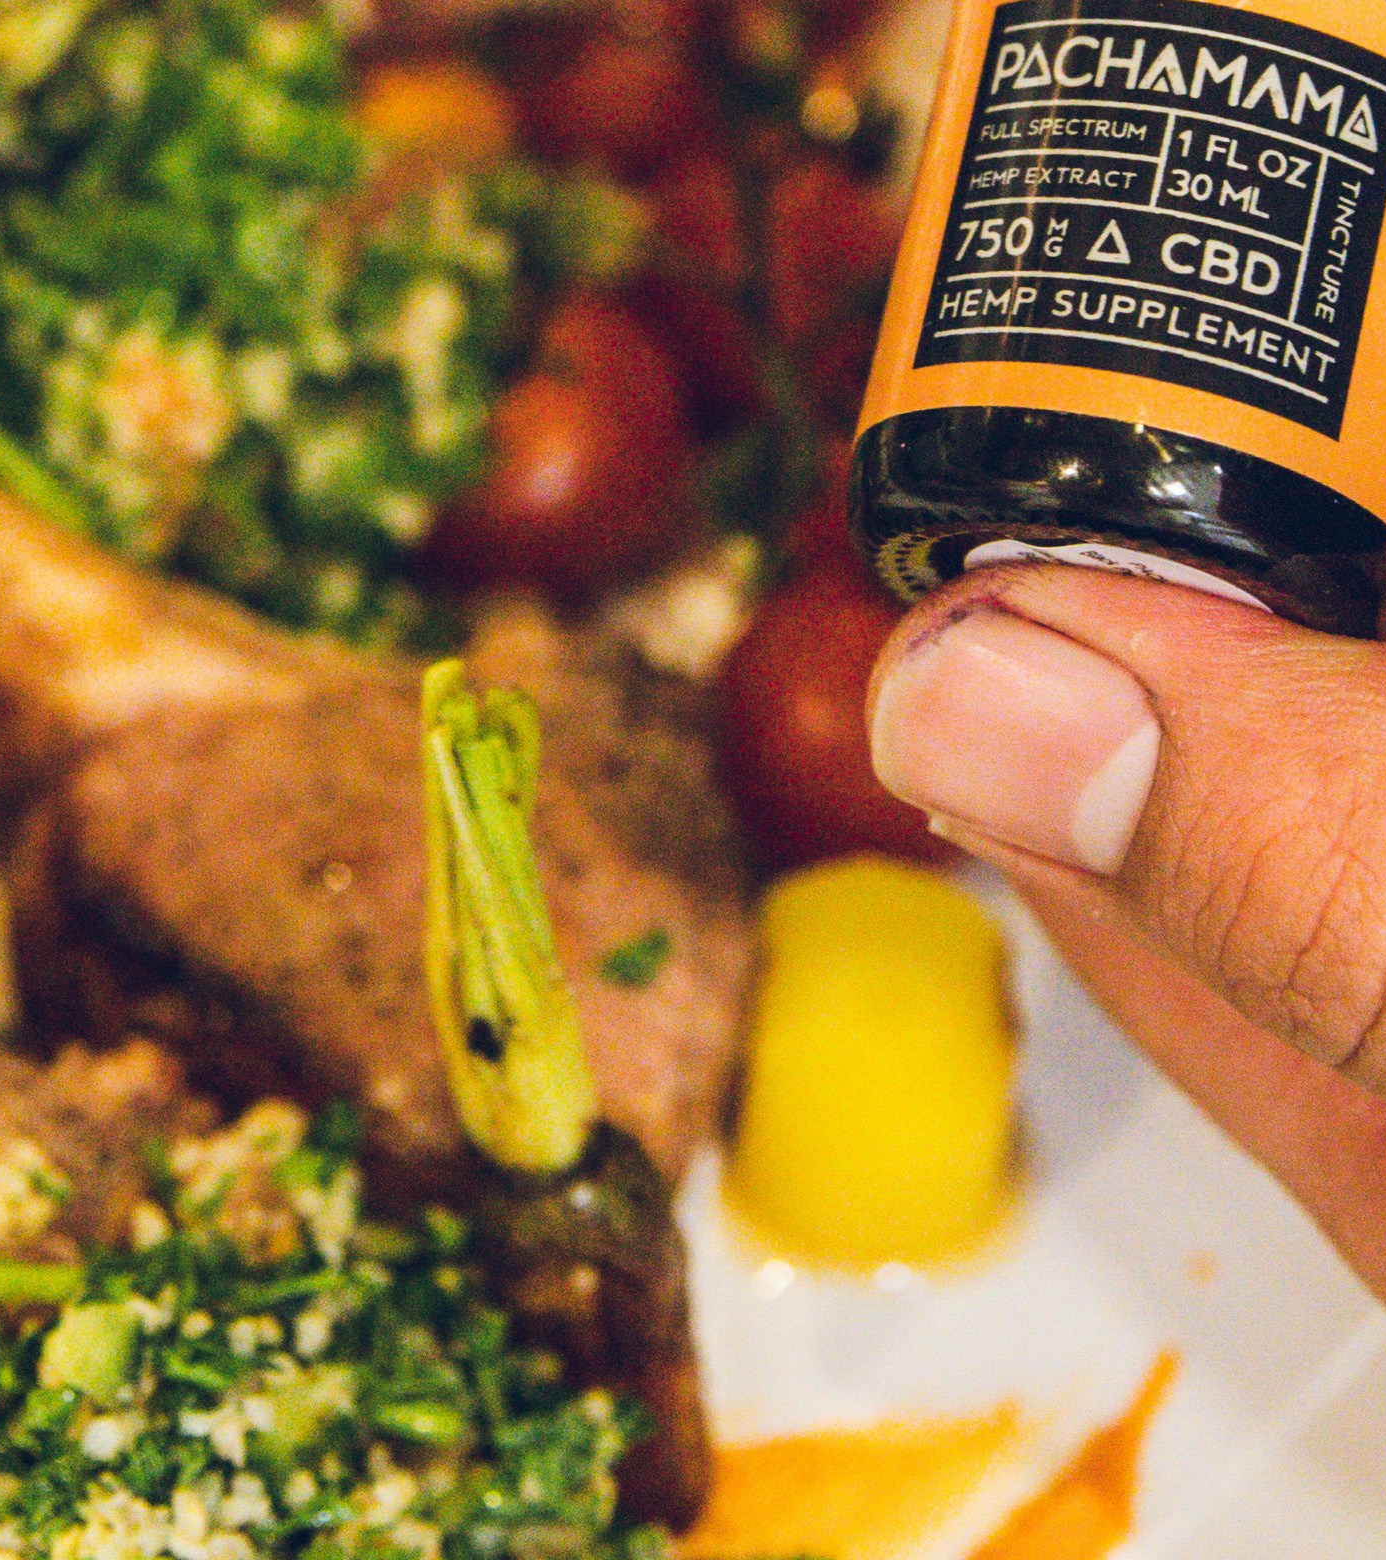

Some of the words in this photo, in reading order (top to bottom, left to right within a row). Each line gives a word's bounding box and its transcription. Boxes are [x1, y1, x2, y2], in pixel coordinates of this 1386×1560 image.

[991, 36, 1380, 149] PACHAMAMA
[980, 116, 1023, 141] FULL
[1028, 117, 1148, 144] SPECTRUM
[1176, 129, 1192, 156] 1
[1205, 136, 1249, 172] FL
[1256, 151, 1311, 189] OZ
[968, 168, 1018, 190] HEMP
[1023, 165, 1138, 190] EXTRACT
[1167, 170, 1212, 200] 30
[1218, 180, 1272, 219] ML
[953, 217, 1032, 262] 750
[1161, 235, 1281, 297] CBD
[1315, 180, 1363, 325] TINCTURE
[939, 284, 1036, 320] HEMP
[1052, 289, 1337, 384] SUPPLEMENT
